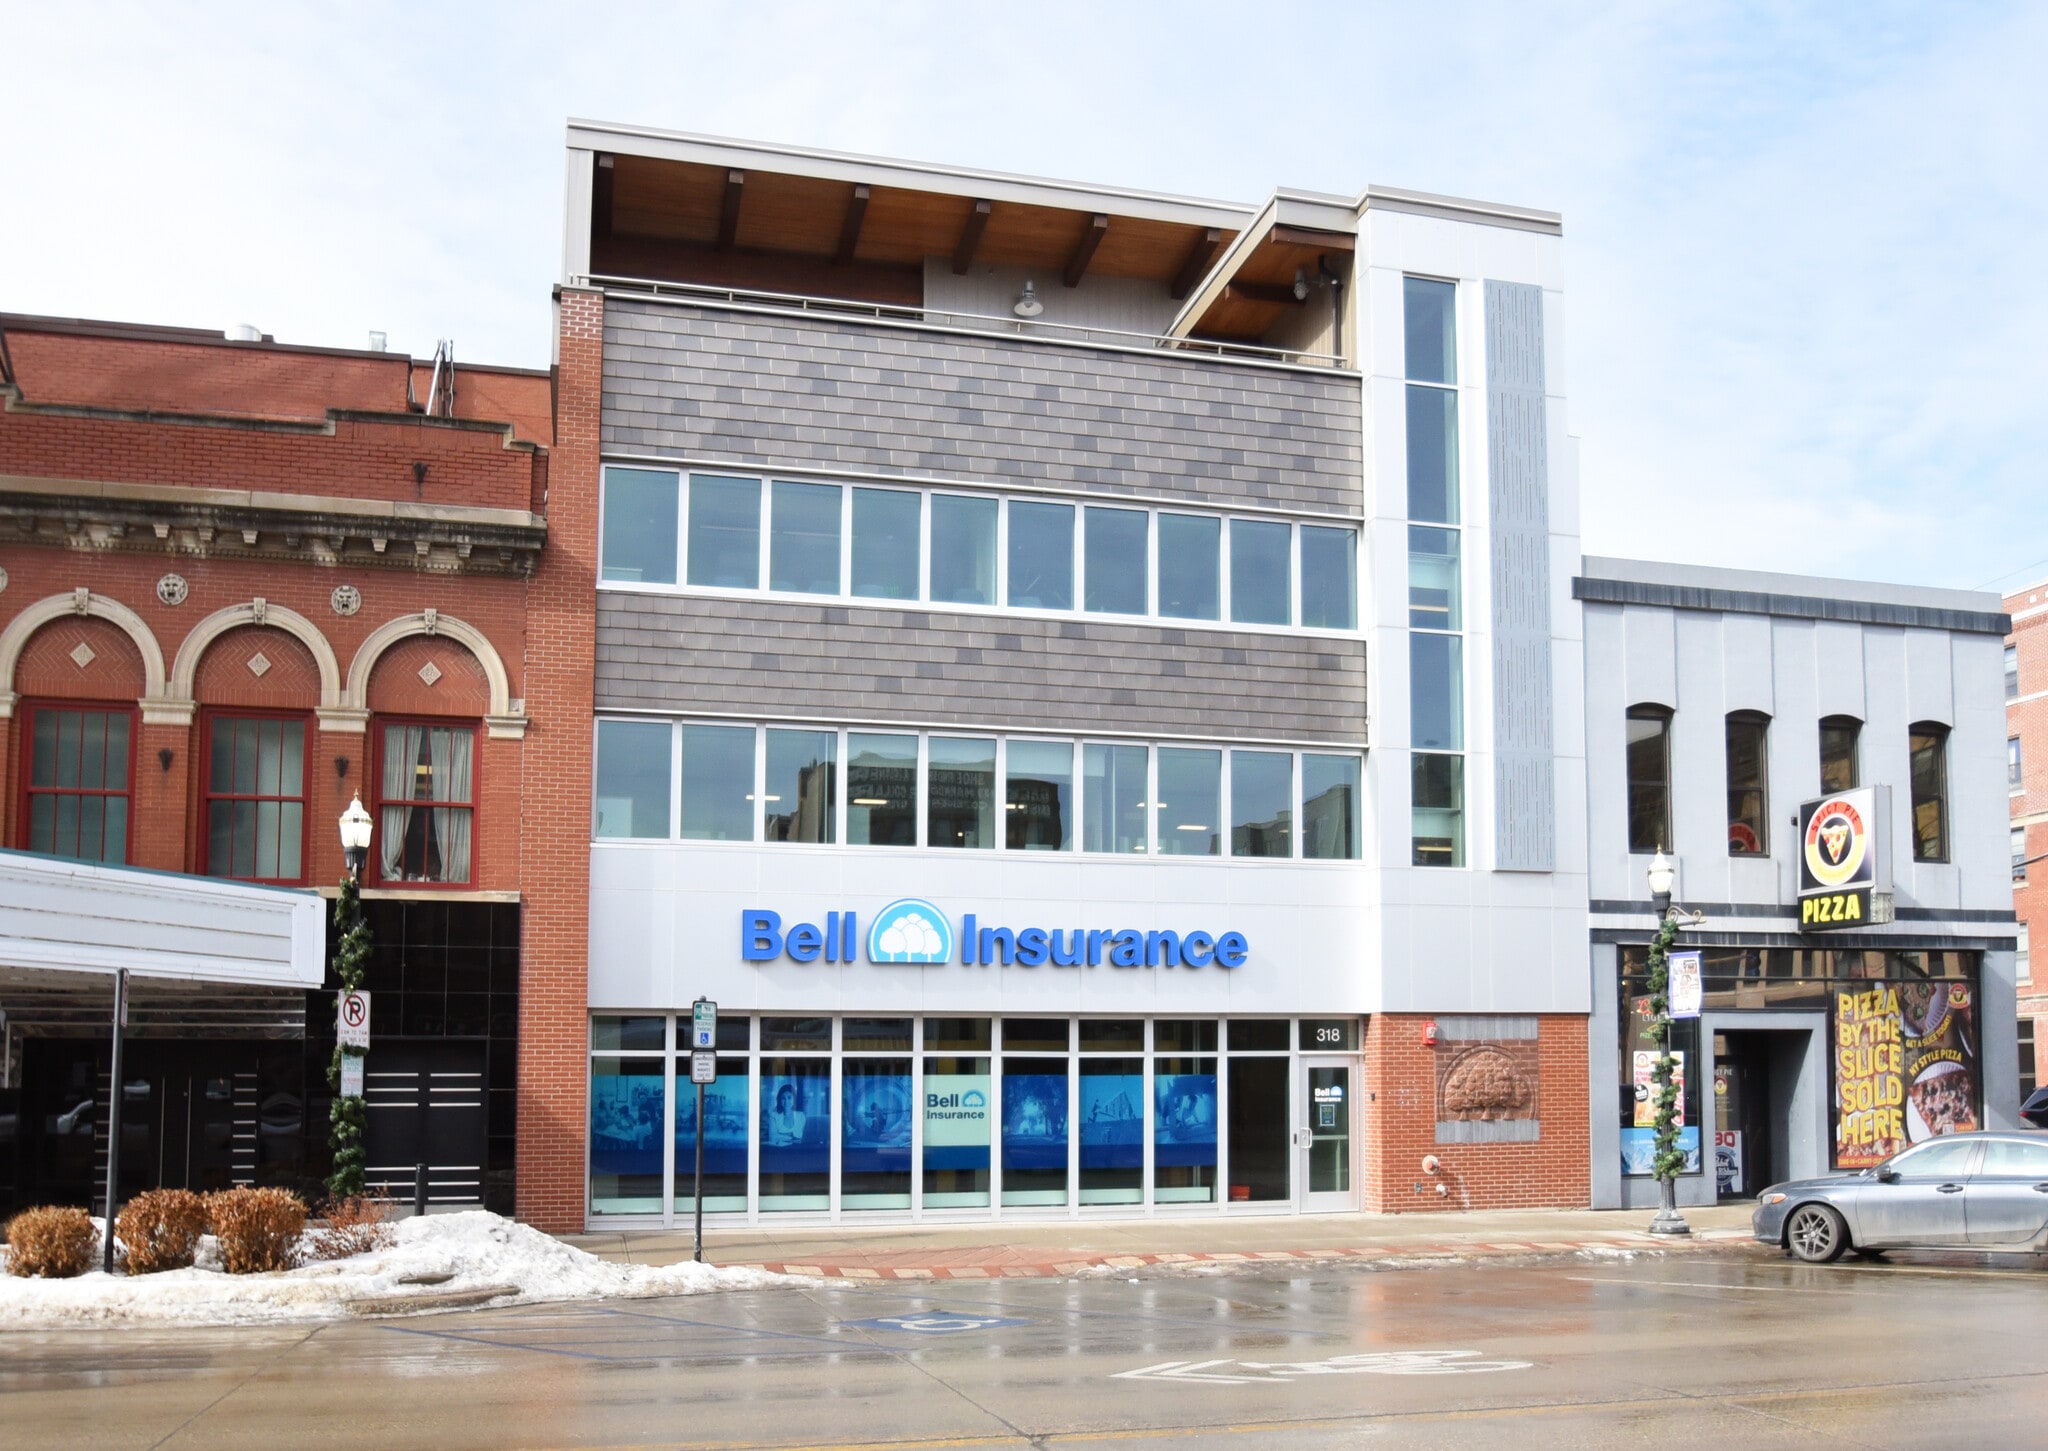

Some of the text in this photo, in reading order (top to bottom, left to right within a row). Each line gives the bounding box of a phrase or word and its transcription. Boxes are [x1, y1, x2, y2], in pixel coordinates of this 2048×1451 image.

[1811, 803, 1859, 832] SPICY PIE
[1802, 893, 1861, 924] PIZZA
[742, 909, 1249, 969] Bell Insurance
[1838, 989, 1900, 1020] PIZZA
[1317, 1028, 1340, 1042] 318
[1839, 1018, 1901, 1047] BY THE
[1840, 1043, 1902, 1080] SLICE
[1908, 1048, 1962, 1077] NY STYLE PIZZA
[927, 1094, 959, 1107] Bell
[1315, 1088, 1330, 1096] Bell
[1840, 1075, 1903, 1115] SOLD
[927, 1110, 985, 1119] Insurance
[1840, 1108, 1903, 1146] HERE
